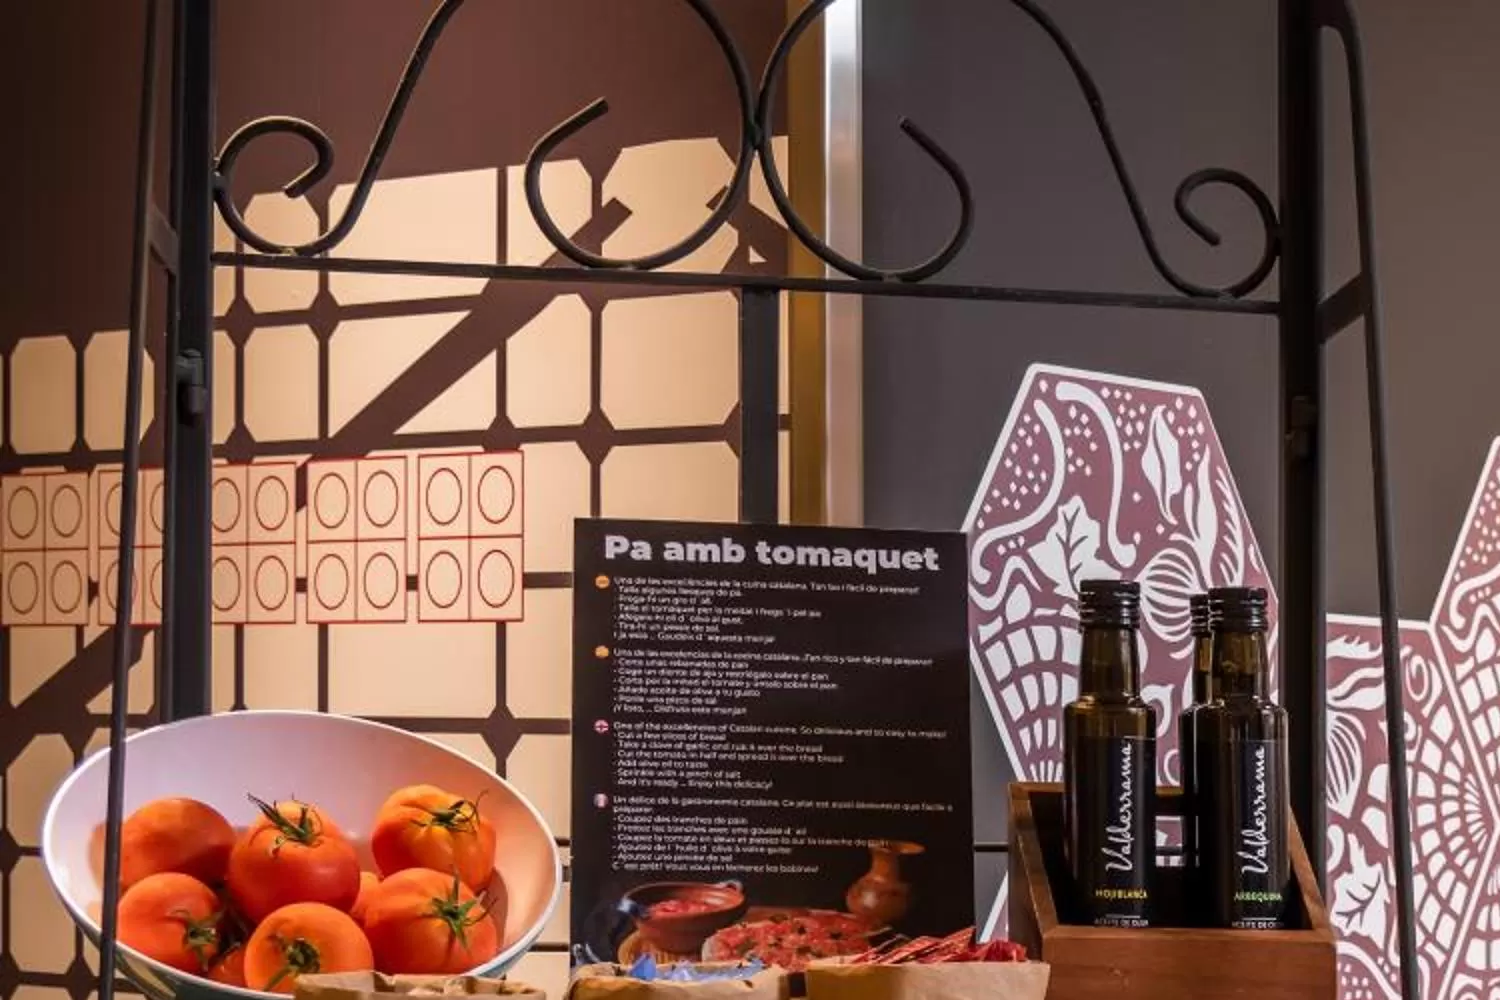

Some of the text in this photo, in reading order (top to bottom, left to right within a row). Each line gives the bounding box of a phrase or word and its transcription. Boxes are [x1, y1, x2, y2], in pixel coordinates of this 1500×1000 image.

[604, 534, 940, 575] Pa amb tomaquet
